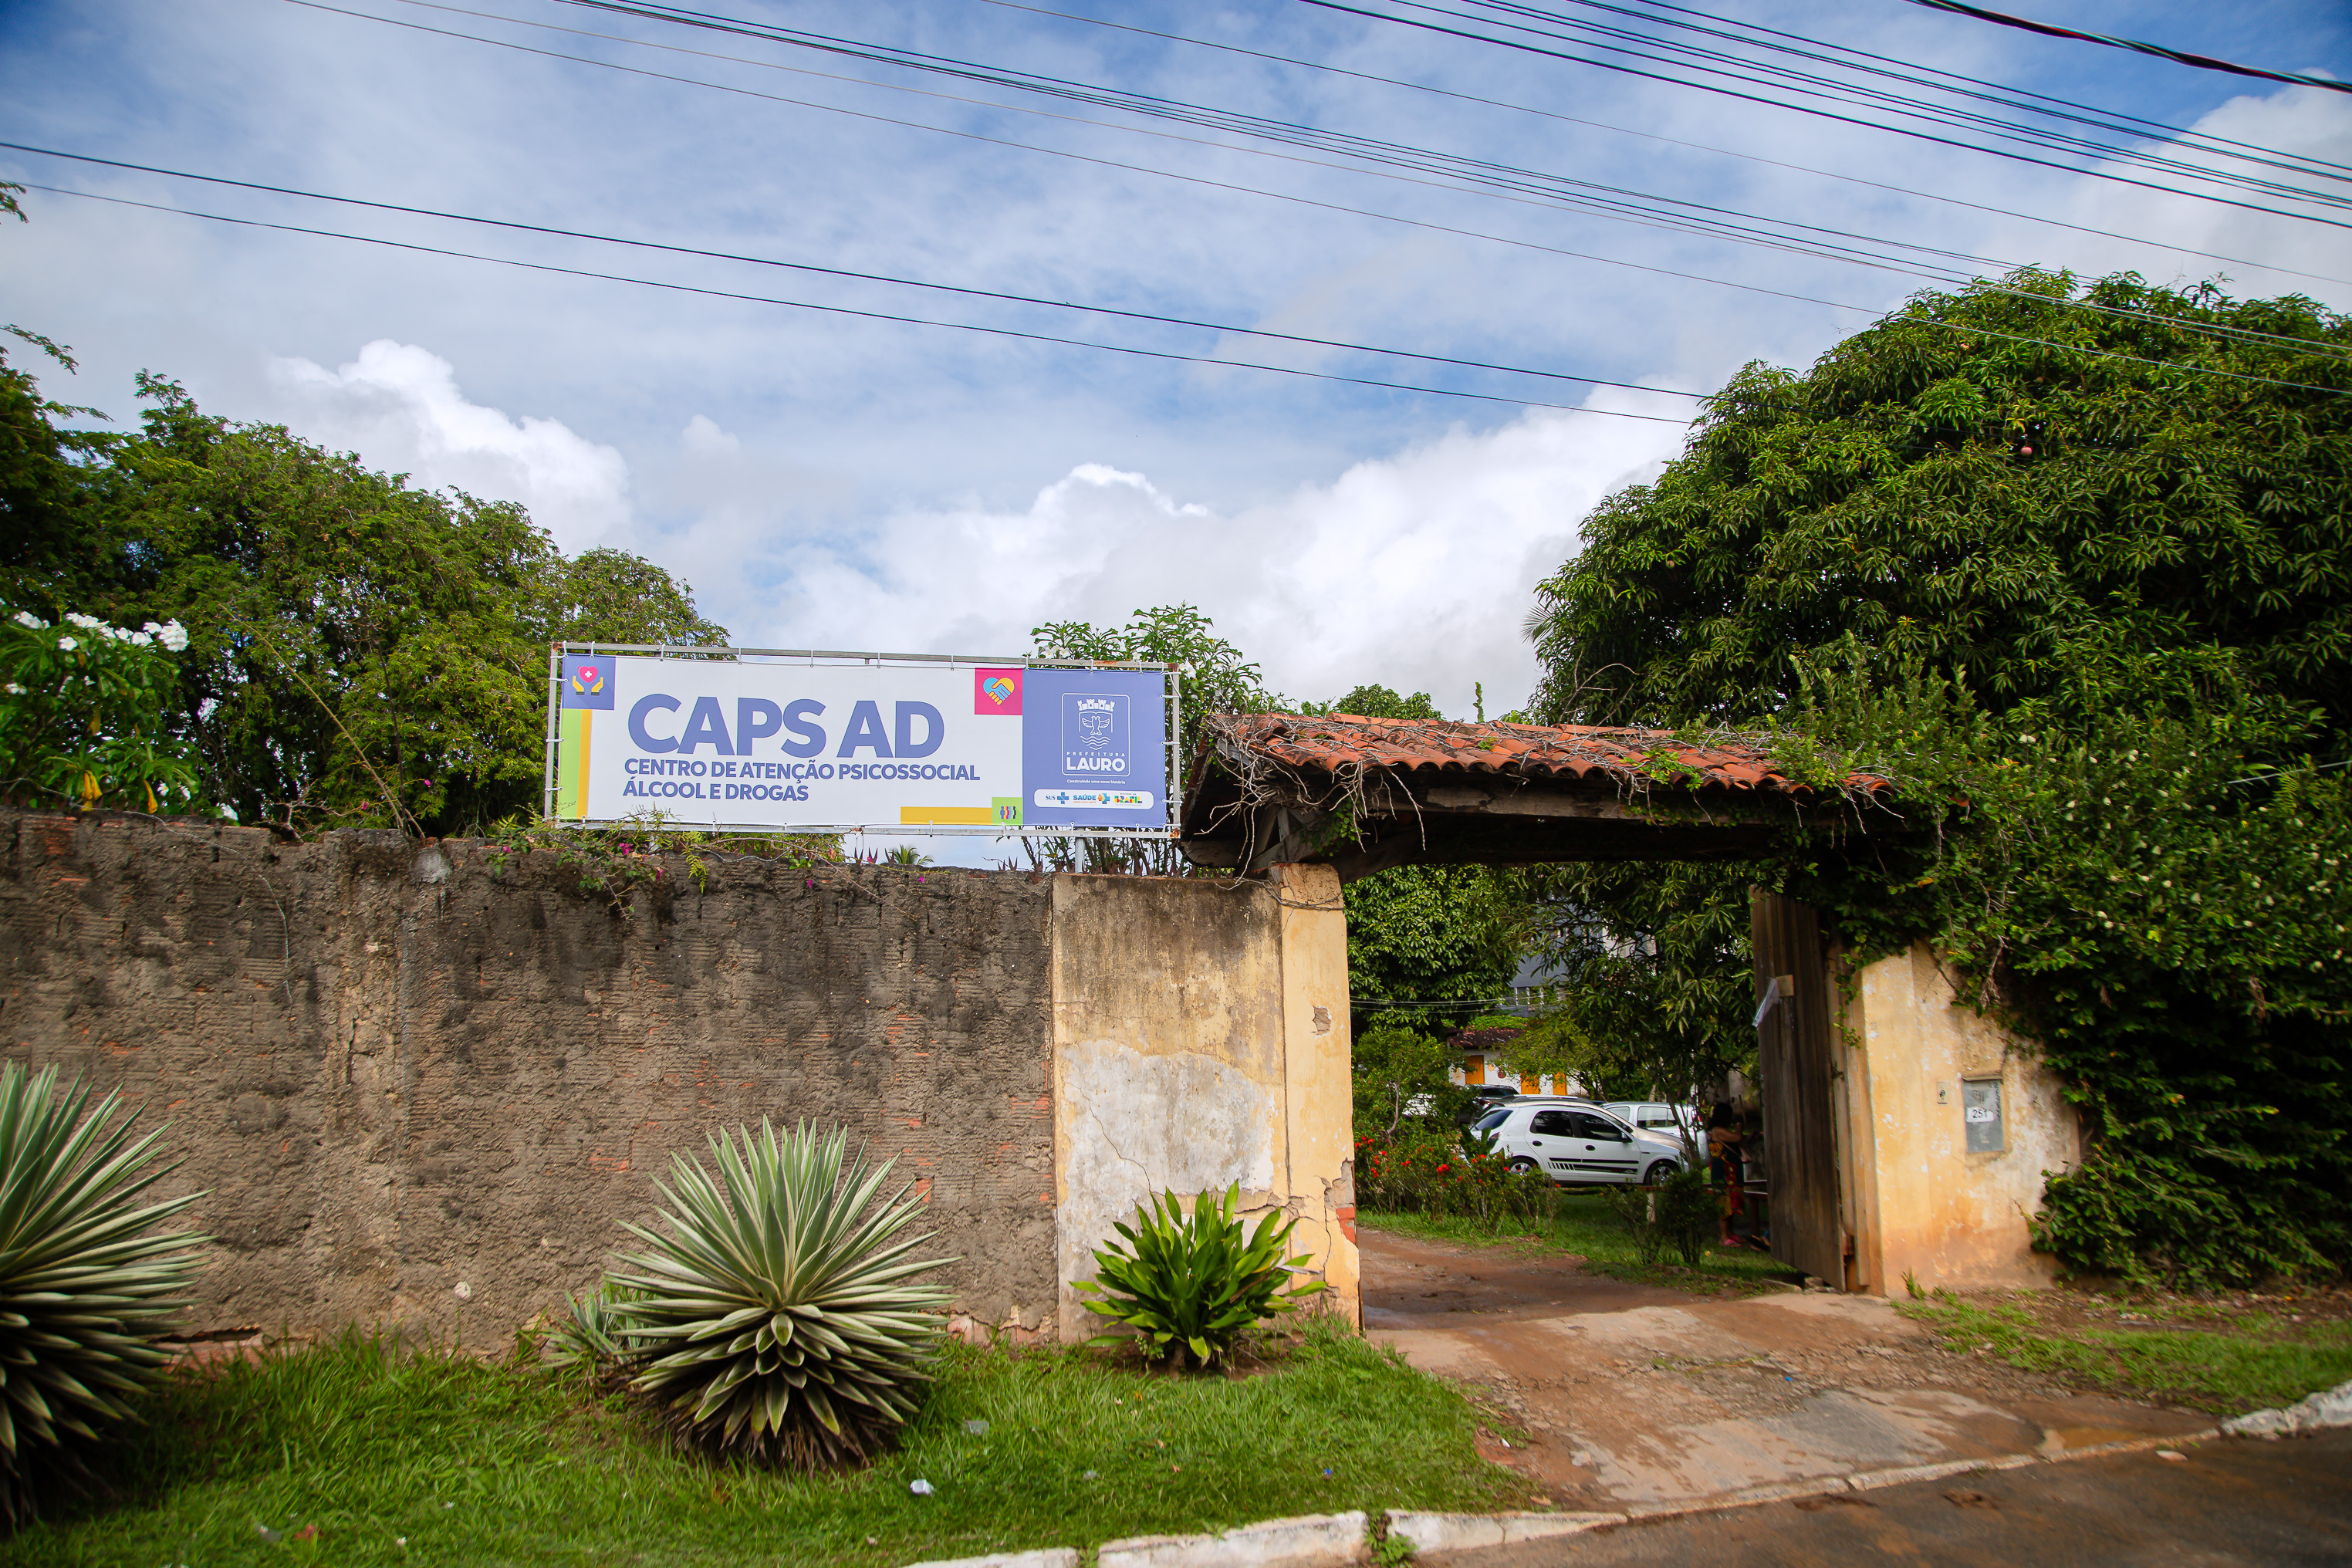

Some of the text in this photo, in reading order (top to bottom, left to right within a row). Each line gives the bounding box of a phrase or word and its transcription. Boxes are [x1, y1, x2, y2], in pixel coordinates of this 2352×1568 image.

[628, 694, 945, 759] CAPS AD
[624, 759, 981, 783] CENTRO DE ATENÇÃO PSICOSSOCIAL
[1066, 757, 1126, 772] LAURO
[623, 776, 809, 801] ÁLCOOL E DROGAS
[1972, 1109, 1988, 1118] 251
